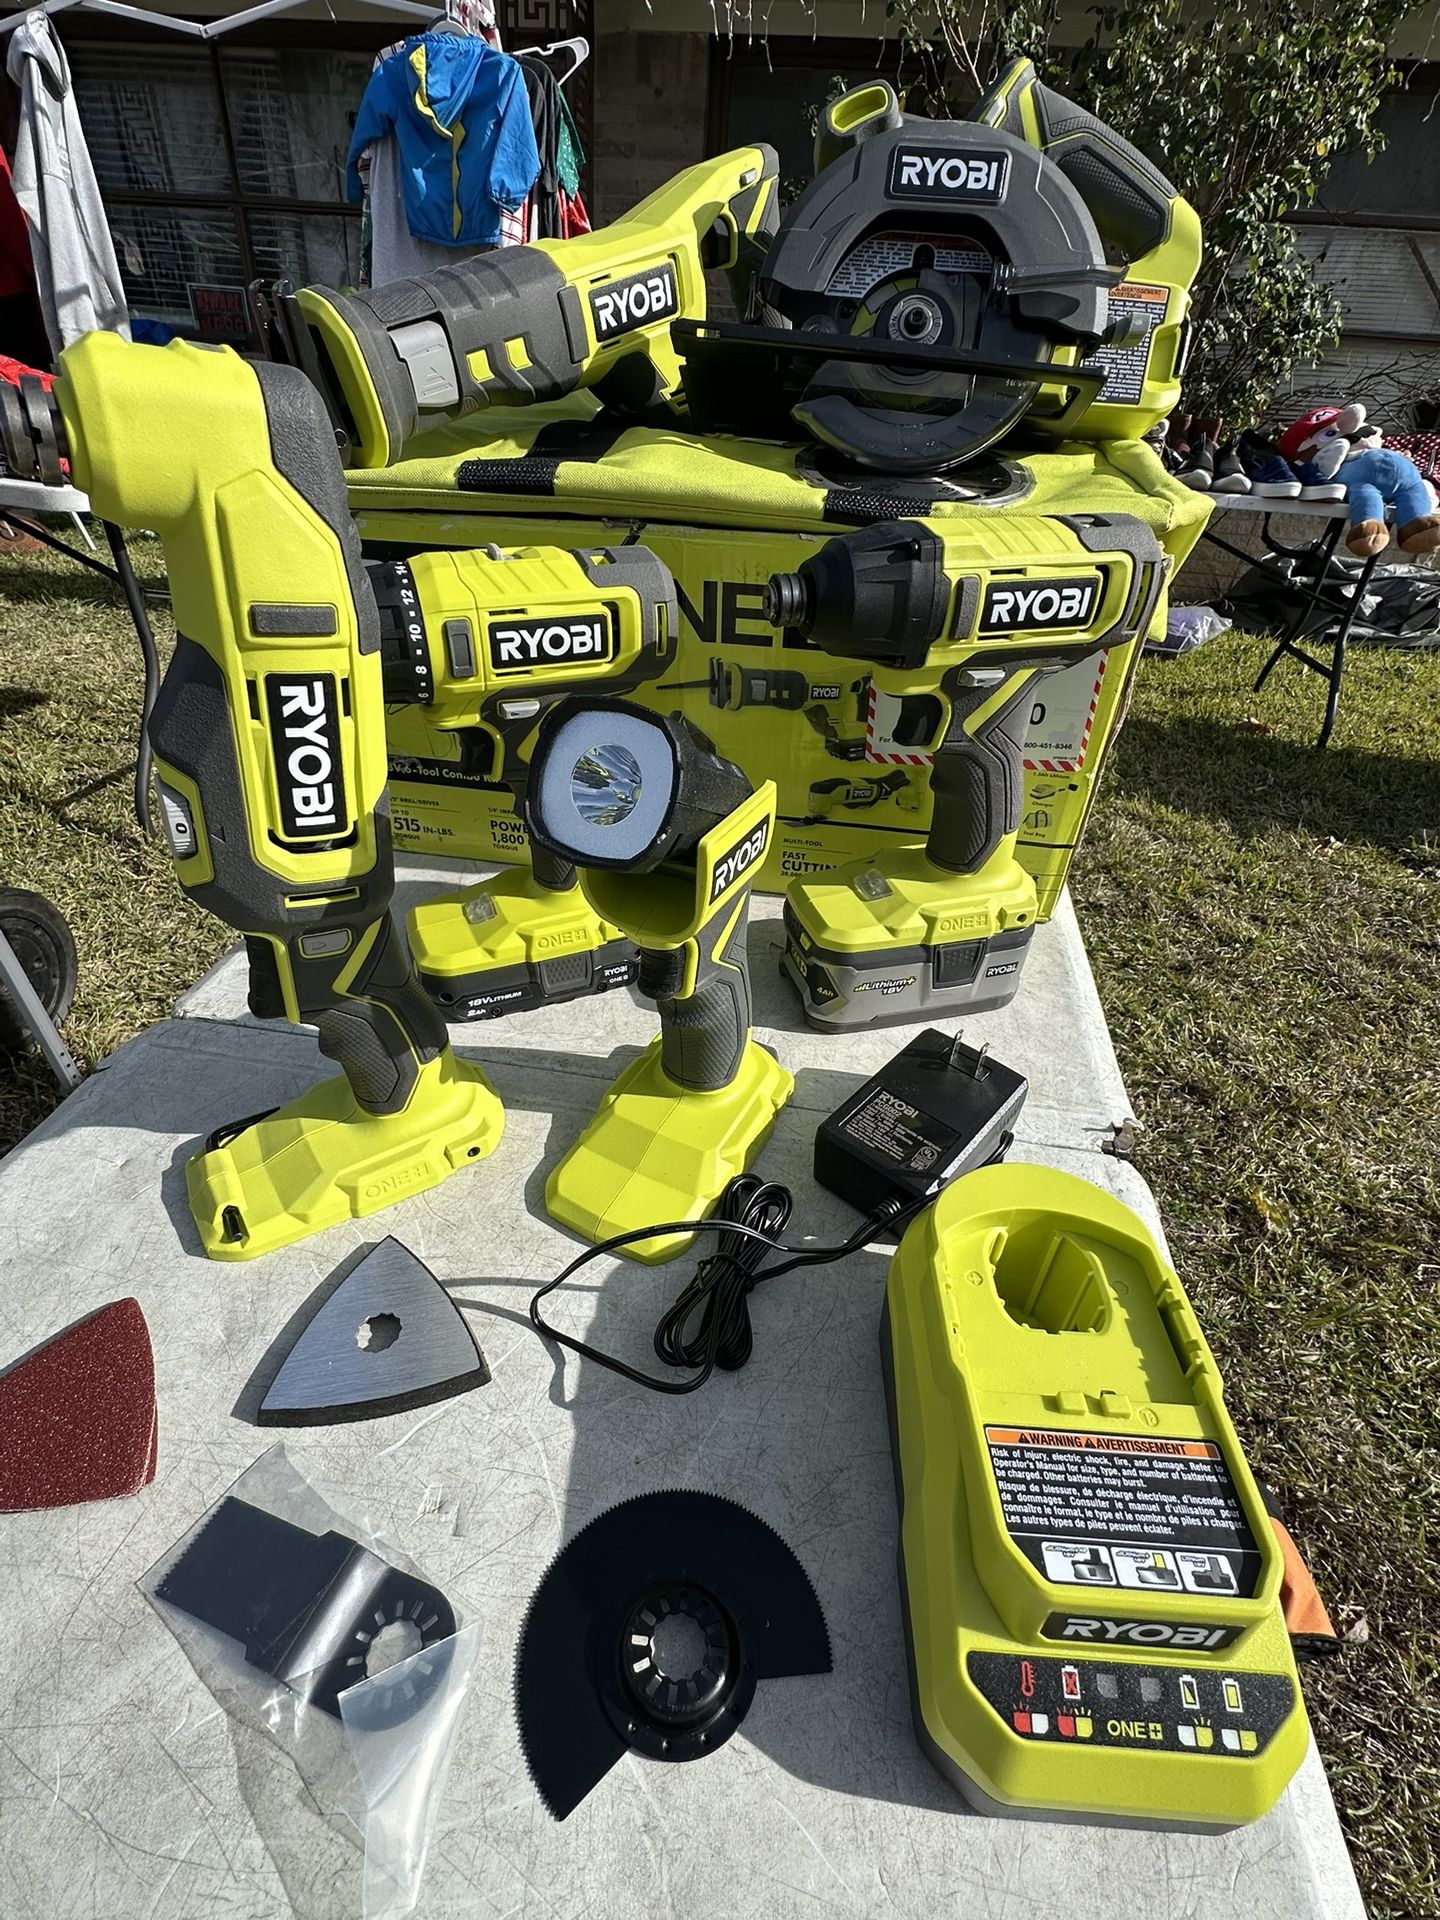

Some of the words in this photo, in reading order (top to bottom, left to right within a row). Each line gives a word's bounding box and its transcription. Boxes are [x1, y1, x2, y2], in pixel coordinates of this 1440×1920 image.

[901, 155, 999, 191] RYOBI
[594, 273, 673, 332] RYOBI
[394, 565, 408, 575] 14
[401, 589, 415, 605] 12
[990, 587, 1092, 623] RYOBI
[674, 578, 773, 647] NE
[408, 624, 422, 642] 10
[495, 623, 602, 661] RYOBI
[415, 665, 428, 675] 8
[812, 687, 839, 698] RYOBI
[279, 681, 336, 827] RYOBI
[393, 817, 421, 832] 515
[423, 826, 456, 837] IN-LBS.
[490, 820, 529, 834] POWE
[491, 831, 525, 845] 1,800
[783, 838, 823, 847] MULTI-TOOL
[714, 823, 768, 896] RYOBI
[782, 851, 807, 860] FAST
[604, 965, 628, 977] RYOBI
[987, 964, 1017, 976] RYOBI
[816, 986, 834, 997] 4Ah
[882, 985, 905, 995] 18V
[878, 1090, 920, 1119] RYOBI
[1029, 1433, 1084, 1448] WARNING
[1096, 1438, 1187, 1455] AVERTISSEMENT
[991, 1447, 1009, 1457] Risk
[1013, 1450, 1021, 1458] of
[1024, 1450, 1050, 1461] injury,
[1052, 1453, 1082, 1462] electric
[1085, 1455, 1112, 1466] shock,
[1114, 1457, 1132, 1467] fire,
[1134, 1459, 1149, 1468] and
[1153, 1459, 1187, 1471] damage.
[1189, 1462, 1212, 1472] Refer
[993, 1458, 1034, 1469] Operator's
[1036, 1462, 1066, 1471] Manual
[1067, 1463, 1079, 1472] for
[1080, 1465, 1100, 1475] size,
[1100, 1466, 1121, 1477] type,
[1121, 1468, 1137, 1476] and
[1138, 1469, 1169, 1479] number
[1171, 1471, 1180, 1480] of
[1180, 1471, 1217, 1483] batteries
[1218, 1474, 1227, 1483] to
[995, 1468, 1006, 1477] be
[1007, 1469, 1042, 1480] charged.
[1043, 1471, 1065, 1481] Other
[1067, 1473, 1104, 1484] batteries
[1104, 1477, 1121, 1487] may
[1123, 1478, 1147, 1488] burst.
[998, 1480, 1027, 1493] Risque
[1029, 1483, 1040, 1492] de
[1042, 1483, 1080, 1497] blessure,
[1082, 1487, 1093, 1497] de
[1096, 1488, 1134, 1501] décharge
[1136, 1490, 1181, 1503] électrique,
[1182, 1494, 1225, 1507] d'incendie
[1001, 1491, 1012, 1501] de
[1016, 1492, 1066, 1505] dommages.
[1070, 1496, 1110, 1508] Consulter
[1114, 1500, 1124, 1509] le
[1128, 1502, 1160, 1512] manuel
[1164, 1503, 1216, 1516] d'utilisation
[1219, 1508, 1240, 1519] pour
[1003, 1502, 1043, 1514] connaître
[1044, 1505, 1053, 1514] le
[1053, 1505, 1085, 1518] format,
[1085, 1508, 1094, 1518] le
[1094, 1509, 1114, 1520] type
[1115, 1511, 1124, 1520] et
[1125, 1511, 1134, 1521] le
[1134, 1512, 1167, 1524] nombre
[1168, 1514, 1180, 1524] de
[1180, 1515, 1202, 1526] piles
[1209, 1518, 1246, 1531] charger.
[1005, 1513, 1021, 1523] Les
[1022, 1515, 1049, 1525] autres
[1050, 1517, 1074, 1528] types
[1074, 1518, 1086, 1528] de
[1086, 1519, 1108, 1531] piles
[1108, 1521, 1143, 1533] peuvent
[1143, 1523, 1175, 1535] éclater.
[1062, 1618, 1227, 1646] RYOBI
